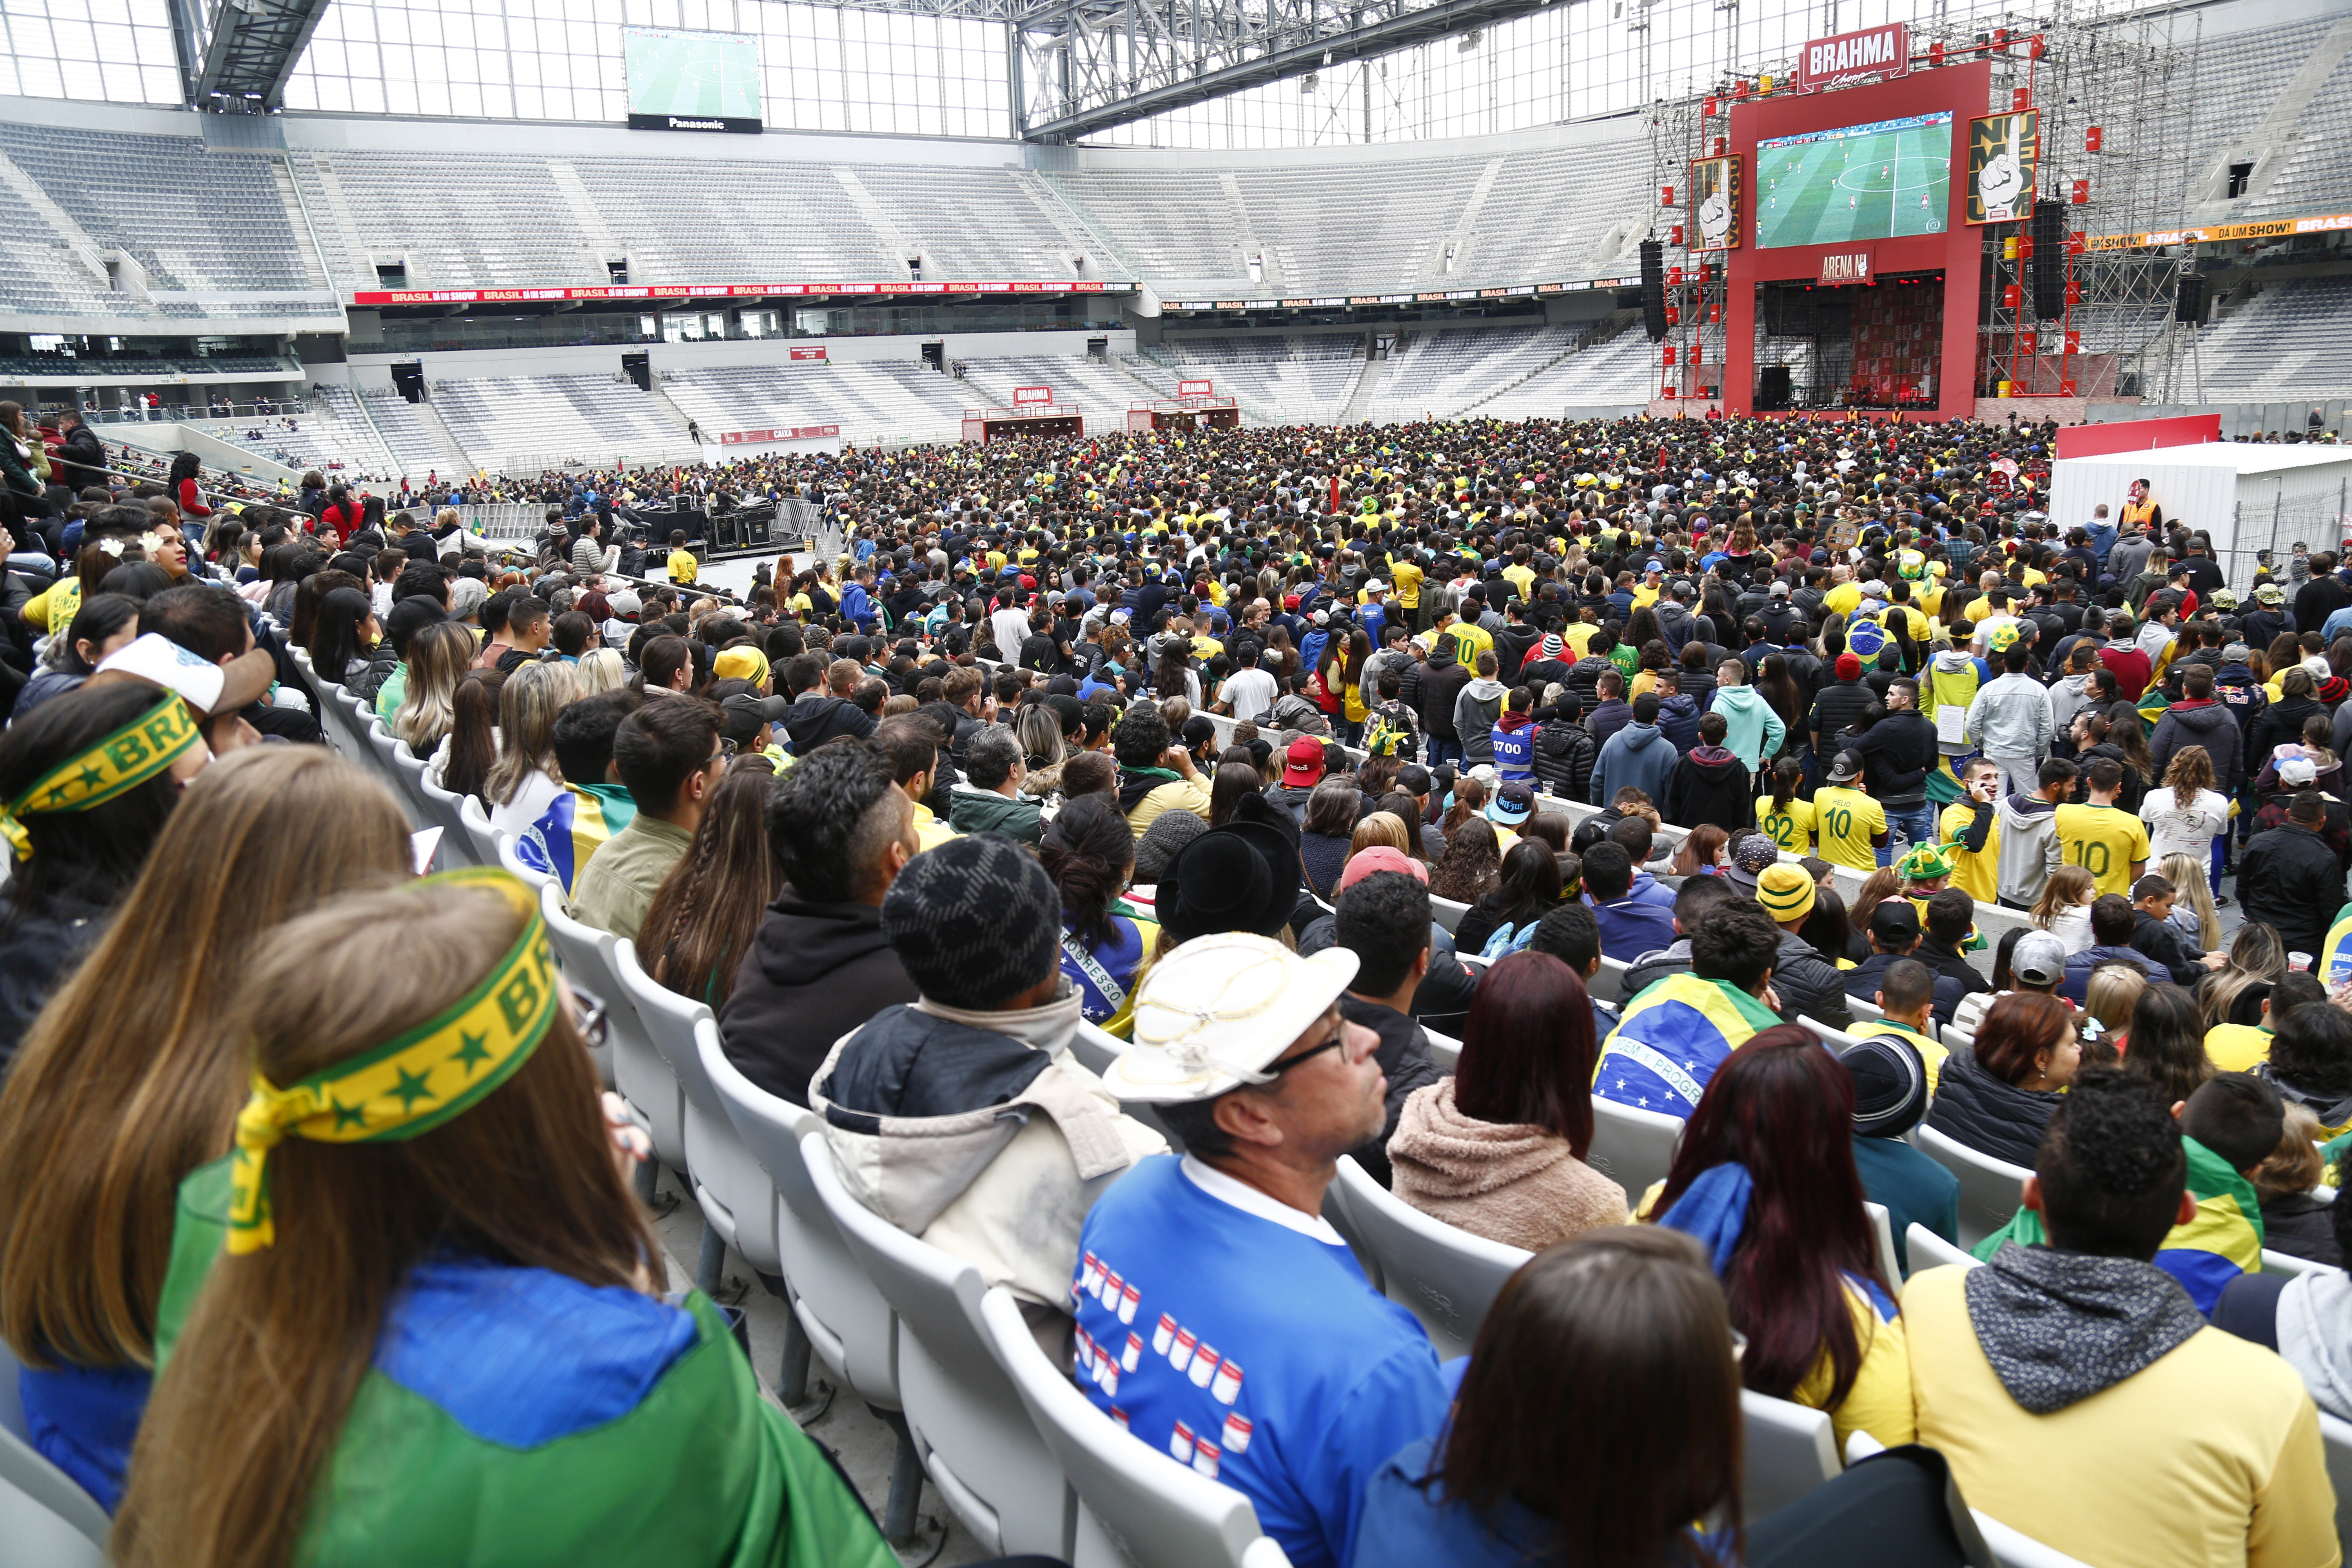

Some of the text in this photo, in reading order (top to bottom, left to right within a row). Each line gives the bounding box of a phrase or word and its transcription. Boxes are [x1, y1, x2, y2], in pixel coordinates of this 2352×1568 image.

[1810, 31, 1895, 76] BRAHMA
[1831, 70, 1876, 85] Chopp
[668, 117, 725, 129] Panasonic
[1729, 159, 1739, 247] VOLTOU
[2296, 216, 2352, 232] BRAS
[2218, 223, 2290, 238] DÁ UM SHOW!
[1822, 255, 1853, 278] ARENA
[809, 285, 840, 293] BRASIL
[840, 284, 846, 293] DÁ
[854, 285, 875, 293] SHOW!
[911, 283, 916, 292] DÁ
[978, 282, 983, 291] DÁ
[1042, 282, 1047, 291] DÁ
[1538, 285, 1562, 293] BRASIL
[1562, 283, 1567, 291] DÁ
[1573, 282, 1590, 290] SHOW!
[1594, 279, 1620, 288] BRASIL
[484, 289, 565, 300] BRASIL DÁ UM SHOW!
[571, 289, 608, 297] BRASIL
[608, 287, 615, 297] DÁ
[624, 288, 648, 297] SHOW!
[654, 287, 689, 296] BRASIL
[689, 286, 695, 295] DÁ
[704, 287, 728, 295] SHOW!
[733, 286, 766, 294] BRASIL
[767, 285, 773, 294] DÁ
[781, 286, 804, 294] SHOW!
[1481, 289, 1507, 297] BRASIL
[1507, 287, 1512, 296] DÁ
[1517, 286, 1535, 294] SHOW!
[392, 291, 477, 302] BRASIL DÁ UM SHOW!
[1380, 295, 1385, 303] DÁ
[1417, 293, 1446, 301] BRASIL
[1446, 291, 1451, 300] DÁ
[1182, 301, 1187, 309] DÁ
[1312, 298, 1317, 306] DÁ
[1182, 382, 1209, 393] BRAHMA
[1017, 389, 1049, 401] BRAHMA
[773, 429, 793, 438] CAIXA
[1453, 628, 1474, 637] NEYMAR
[1610, 657, 1630, 668] ASIL
[2229, 695, 2249, 704] Bull
[1493, 740, 1521, 755] 0700
[1832, 798, 1851, 808] HELIO
[1590, 820, 1611, 832] NIKE
[1825, 807, 1851, 839] 10
[1764, 814, 1793, 846] 92
[2073, 839, 2109, 878] 10
[1654, 1059, 1701, 1102] PROGR
